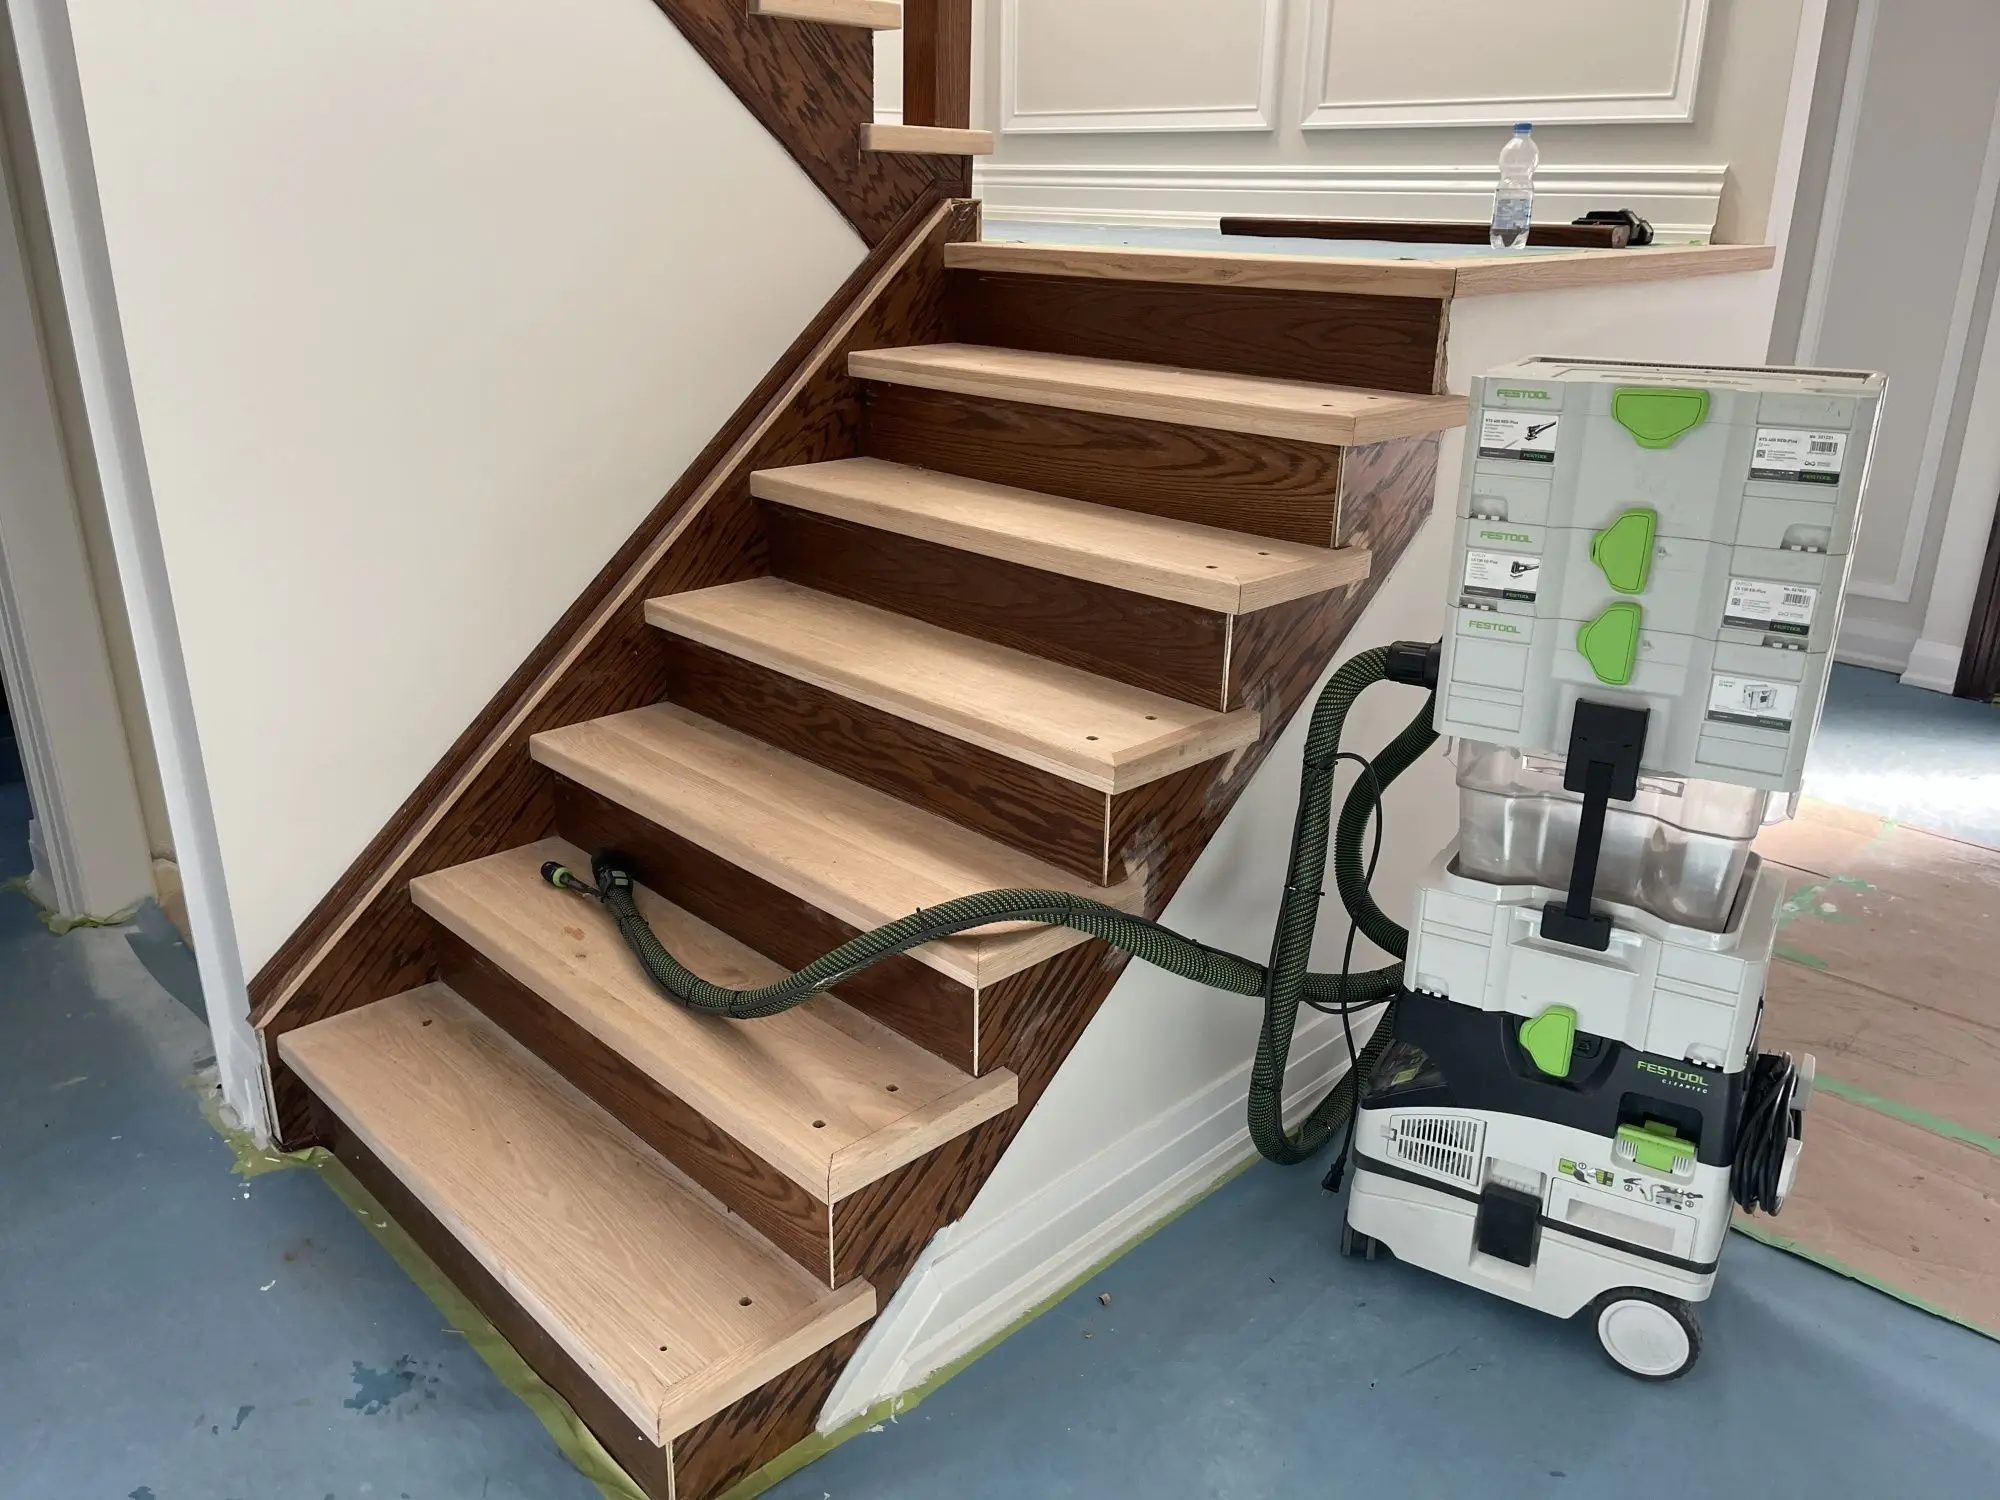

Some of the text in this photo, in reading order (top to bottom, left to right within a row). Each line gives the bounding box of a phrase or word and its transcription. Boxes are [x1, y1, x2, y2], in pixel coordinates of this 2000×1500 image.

[1496, 389, 1551, 400] FESTOOL
[1480, 531, 1533, 543] FESTOOL
[1468, 619, 1521, 634] FESTOOL
[1637, 1060, 1710, 1087] FESTOOL
